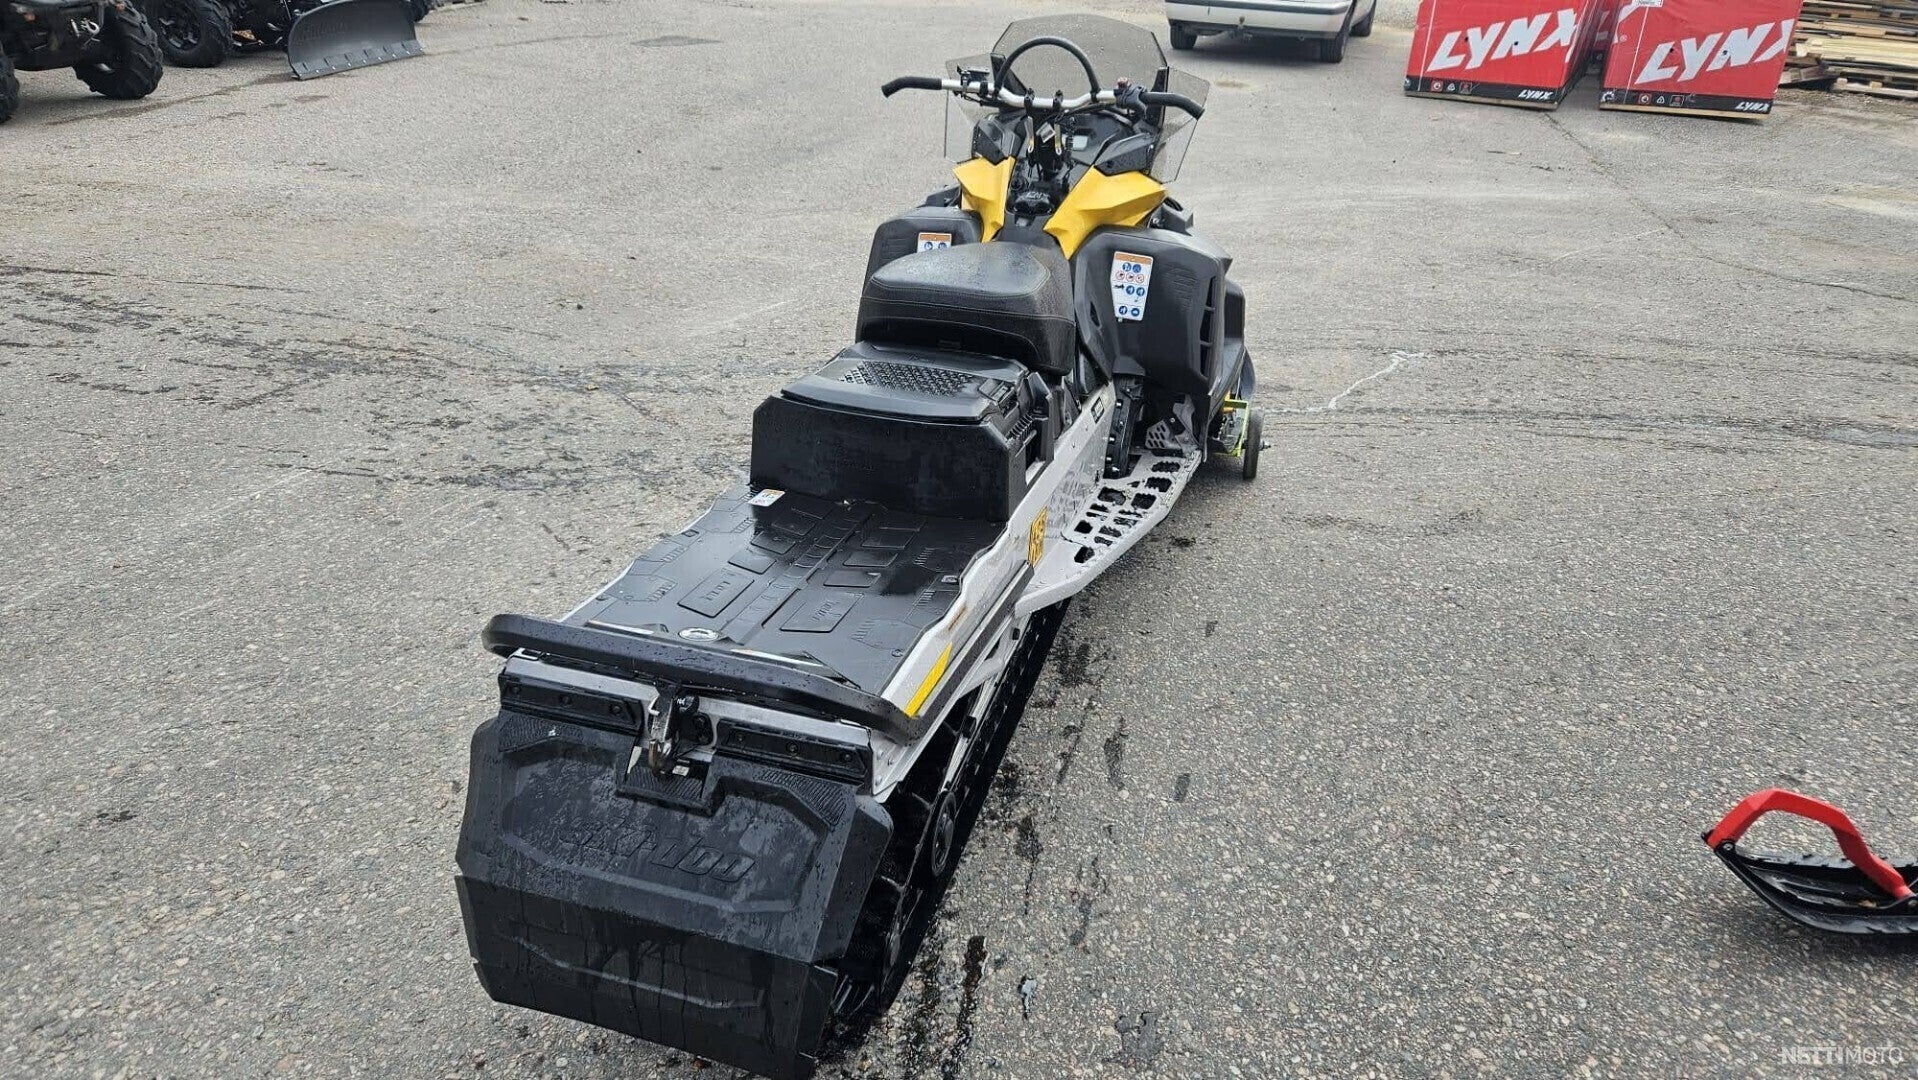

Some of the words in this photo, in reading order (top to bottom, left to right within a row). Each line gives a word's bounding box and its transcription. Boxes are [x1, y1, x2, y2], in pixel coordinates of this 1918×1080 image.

[1426, 8, 1578, 73] LYNX
[1634, 18, 1795, 85] LYNX
[1518, 89, 1553, 101] LYNX
[1735, 101, 1770, 113] LYNX
